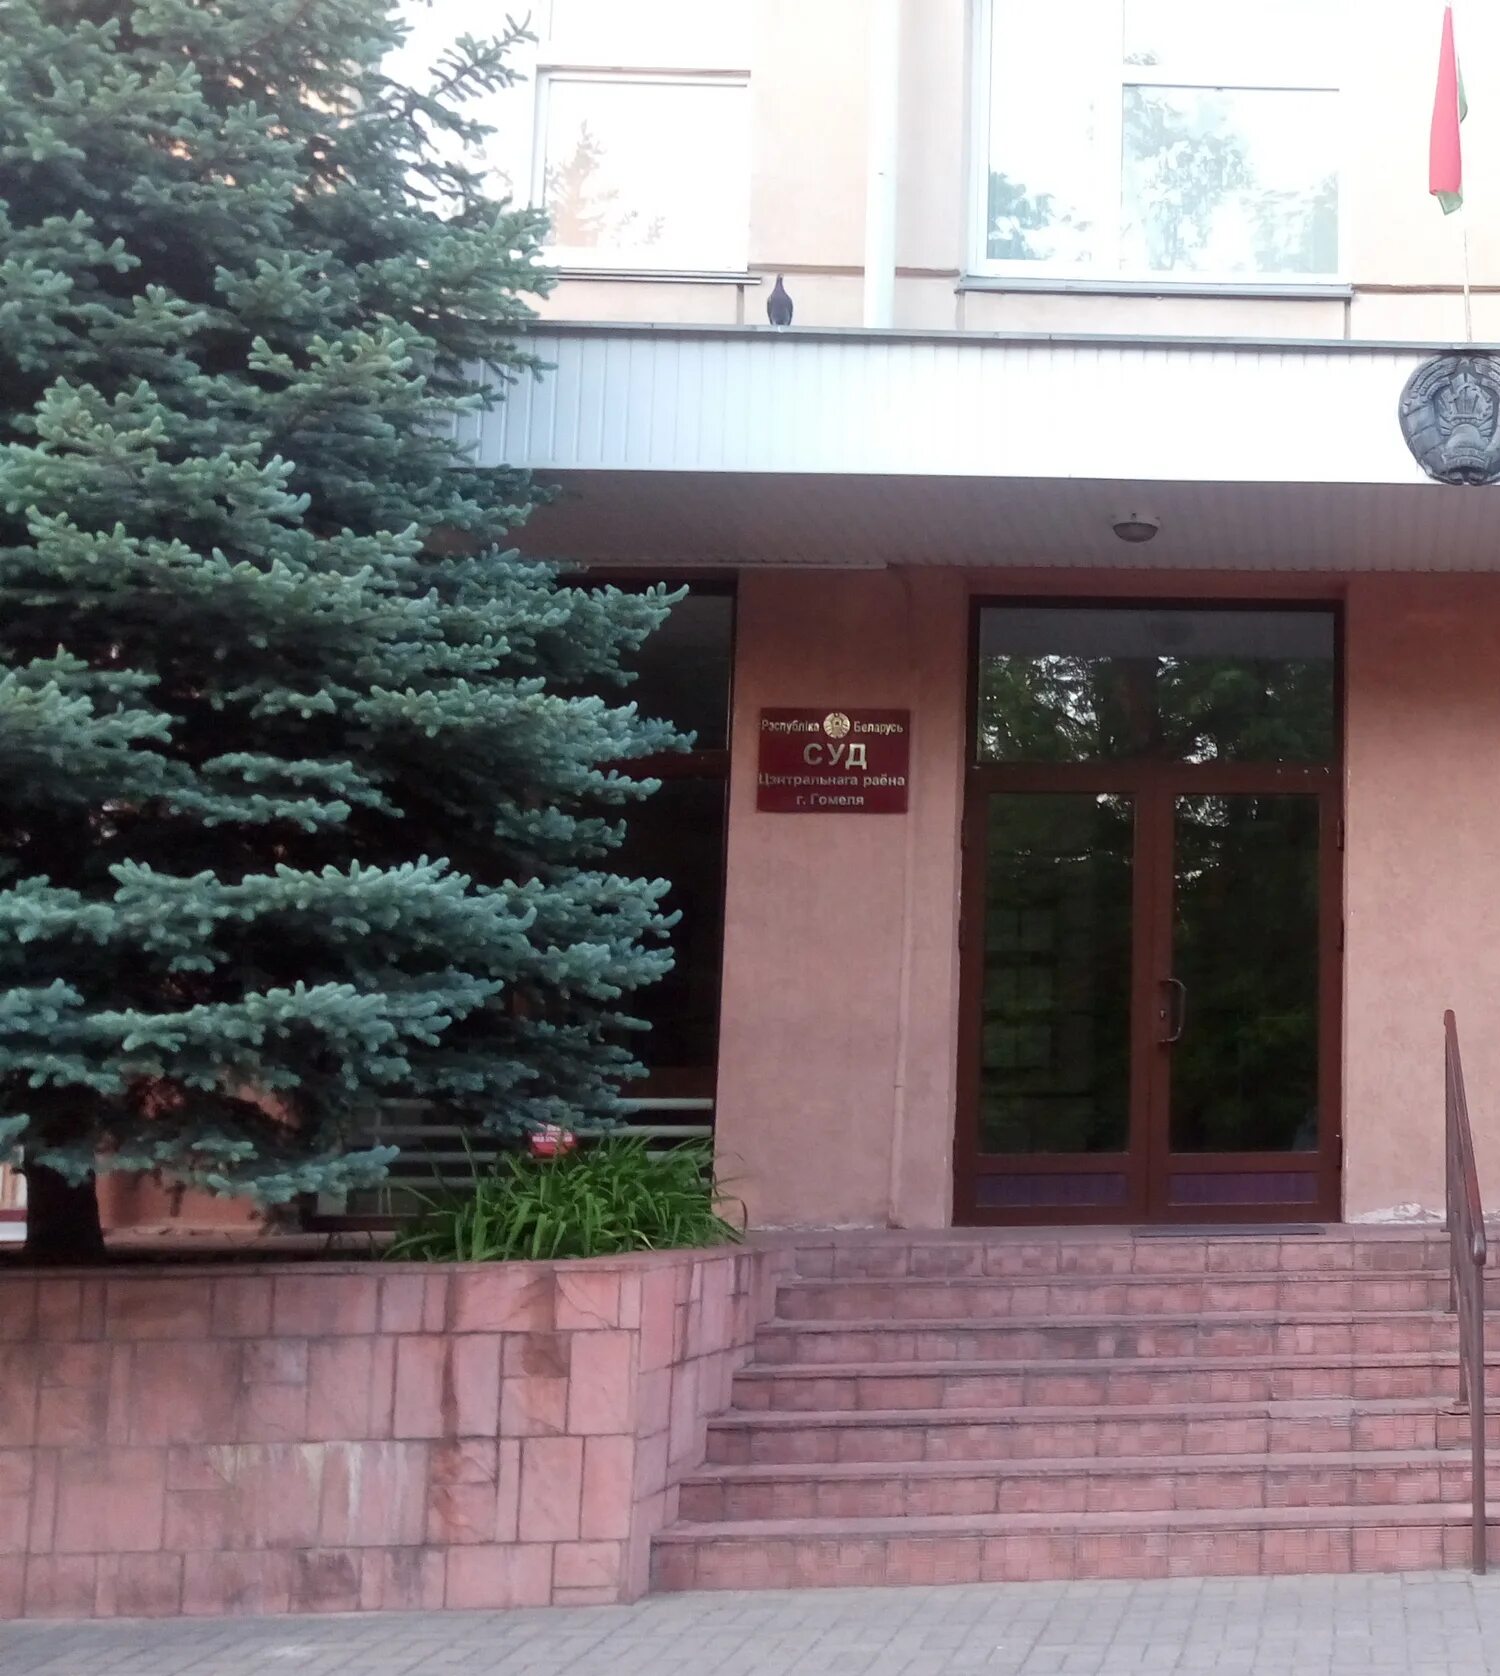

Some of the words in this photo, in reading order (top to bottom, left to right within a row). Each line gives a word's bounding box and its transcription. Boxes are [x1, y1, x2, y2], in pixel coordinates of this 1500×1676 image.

[762, 720, 819, 734] Рэспубліка
[854, 721, 903, 735] Беларусь
[803, 743, 867, 770] СУД
[759, 773, 858, 787] Цэнтральнага
[864, 774, 905, 788] раёна
[796, 796, 806, 805] г.
[811, 793, 864, 806] Гомеля
